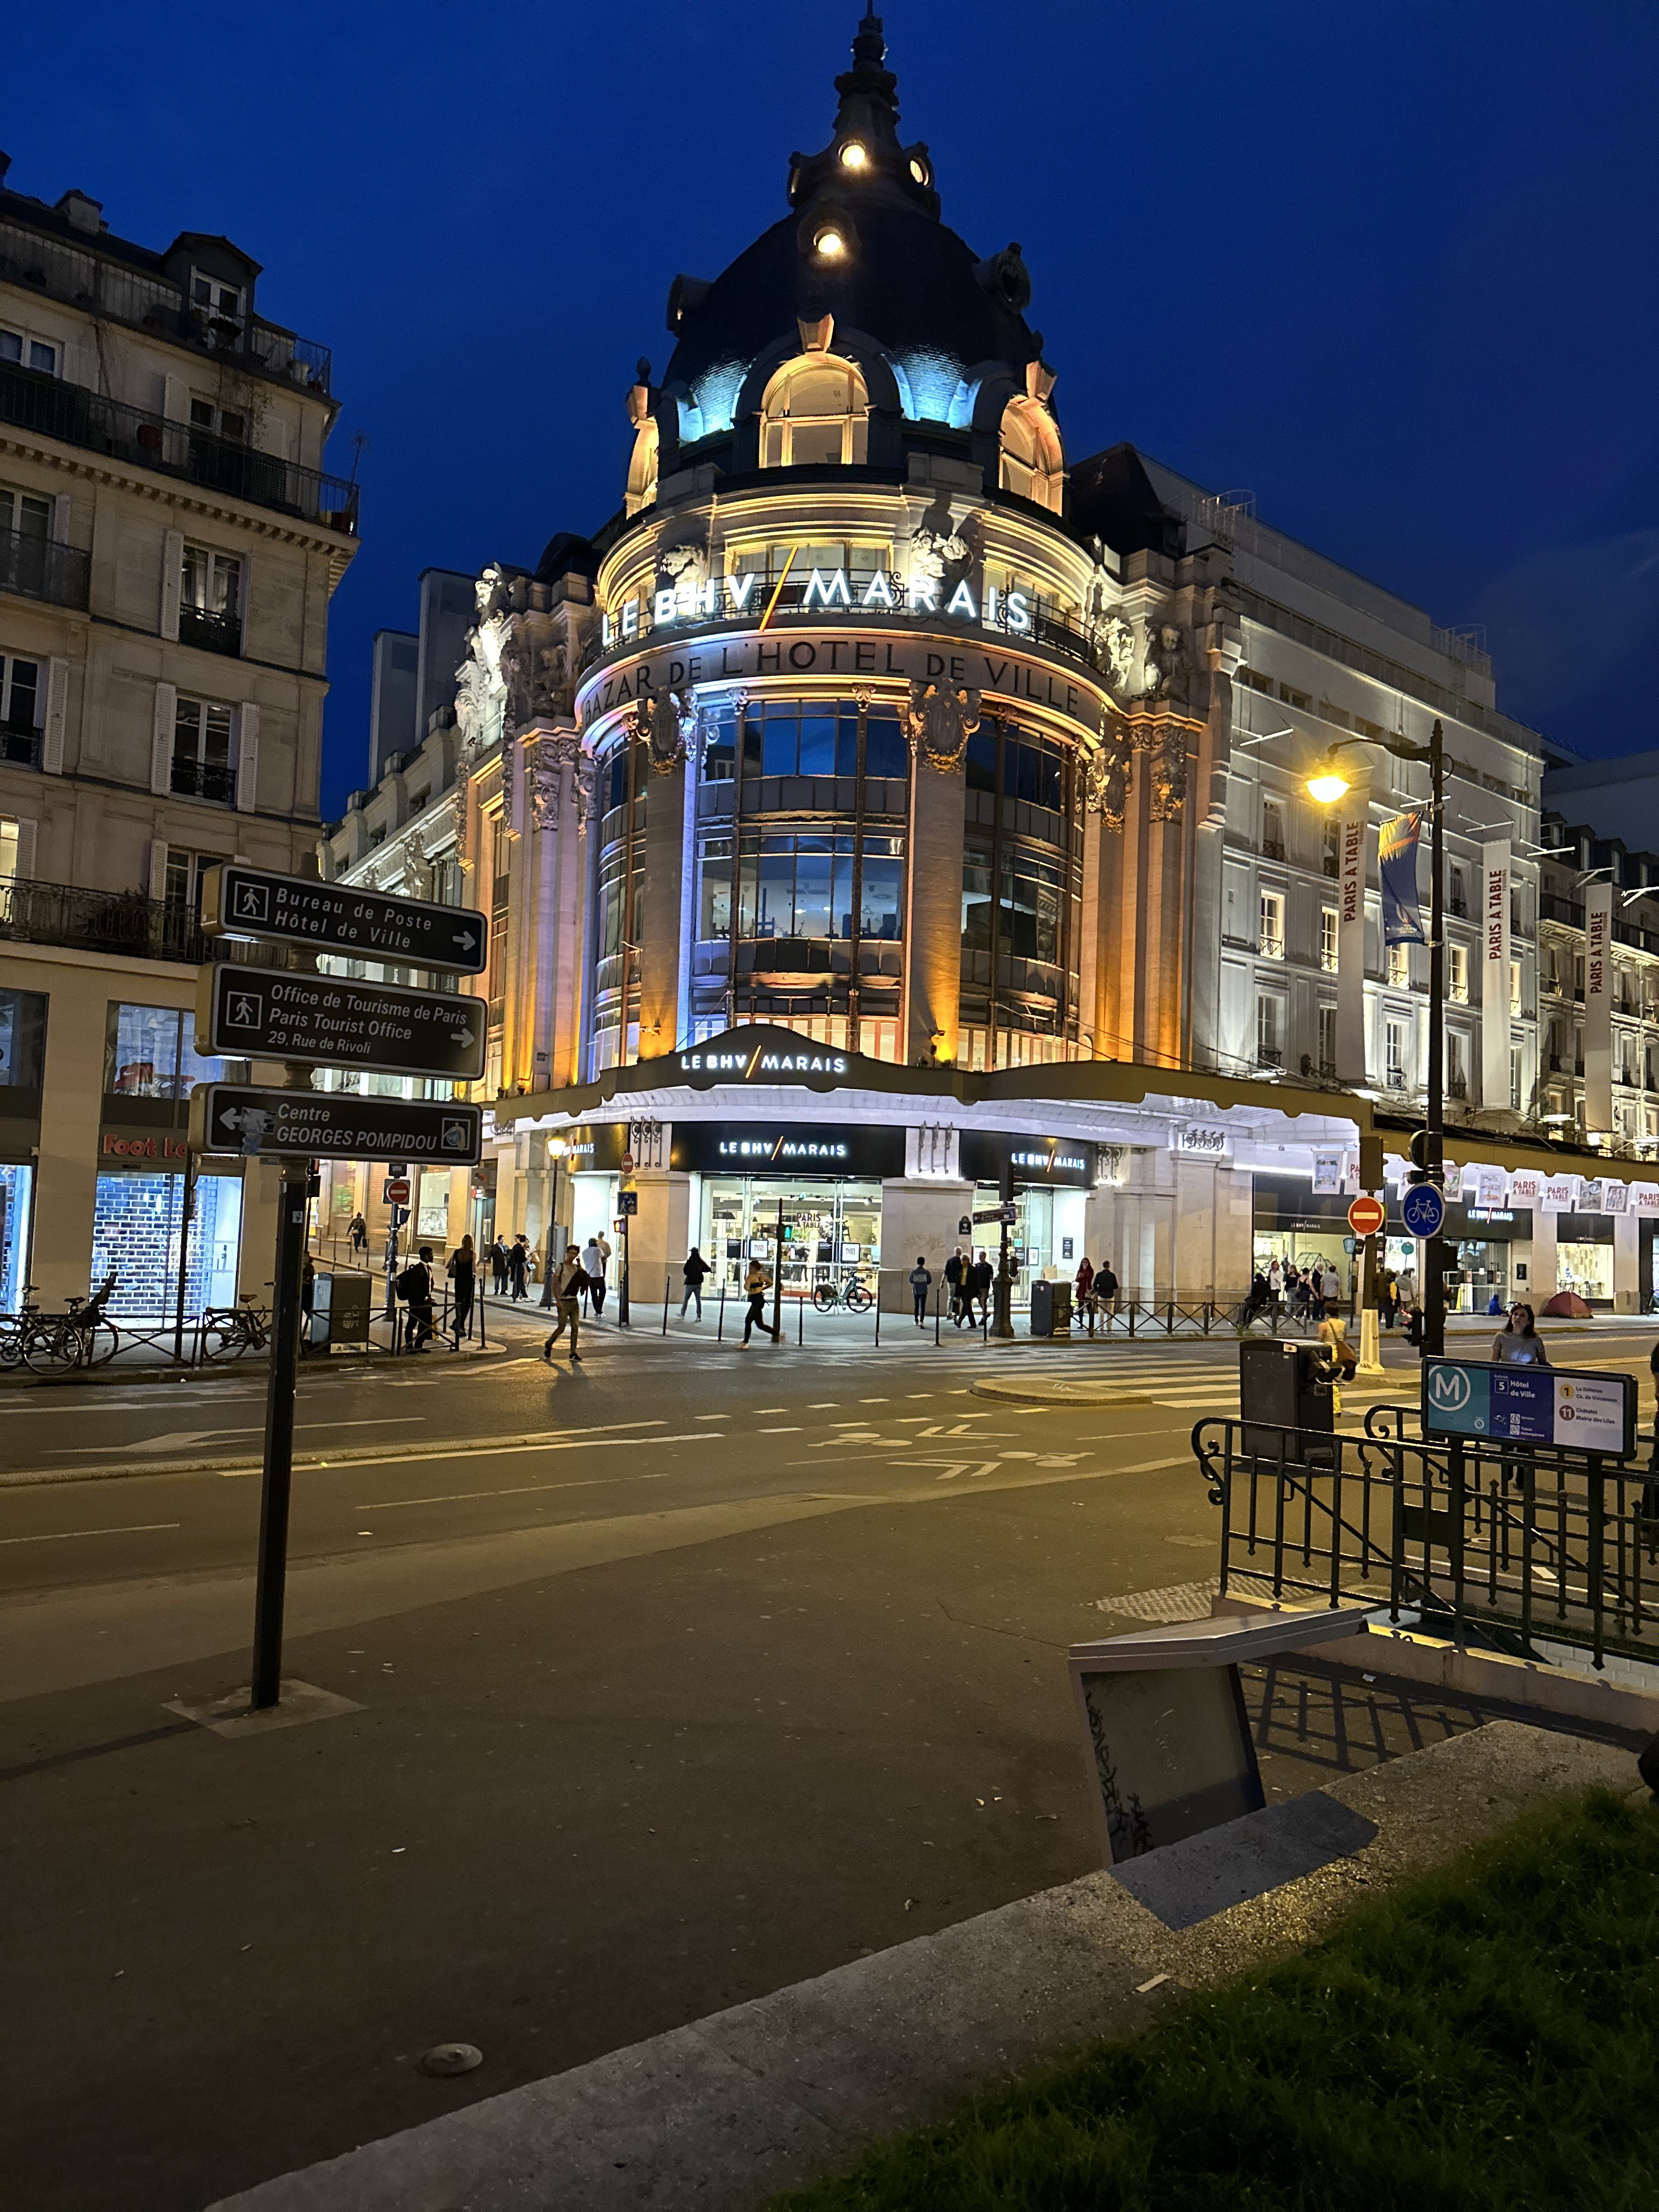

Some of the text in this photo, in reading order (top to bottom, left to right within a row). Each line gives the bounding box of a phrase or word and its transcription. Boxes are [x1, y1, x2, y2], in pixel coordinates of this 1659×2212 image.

[602, 568, 1029, 646] LE BHV MARAIS
[585, 665, 653, 726] BAZAR
[670, 657, 701, 685] DE
[926, 653, 964, 680] DE
[984, 657, 1078, 715] VILLE
[1345, 822, 1358, 865] TABLE
[1344, 881, 1356, 922] PARIS
[1489, 870, 1502, 909] TABLE
[276, 888, 432, 930] Bureau de Poste
[275, 911, 411, 948] Hôtel de Ville
[1489, 923, 1502, 960] PARIS
[1590, 912, 1602, 947] TABLE
[1590, 960, 1602, 994] PARIS
[272, 985, 467, 1025] Office de Tourisme de Paris
[269, 1008, 412, 1040] Paris Tourist Office
[268, 1031, 371, 1054] 29, Rue de Rivoli
[681, 1054, 845, 1073] LE BHV MARAIS
[278, 1103, 330, 1122] Centre
[103, 1134, 156, 1157] Foot
[276, 1126, 352, 1146] GEORGES
[356, 1132, 436, 1151] POMPIDOU
[720, 1142, 845, 1155] LE BHV MARAIS
[1012, 1153, 1025, 1164] LE
[1053, 1157, 1085, 1170] MARAIS
[797, 1212, 821, 1222] PARIS
[1436, 1373, 1459, 1401] M
[1499, 1382, 1505, 1390] 5
[1564, 1387, 1568, 1396] 1
[1561, 1408, 1572, 1418] 11
